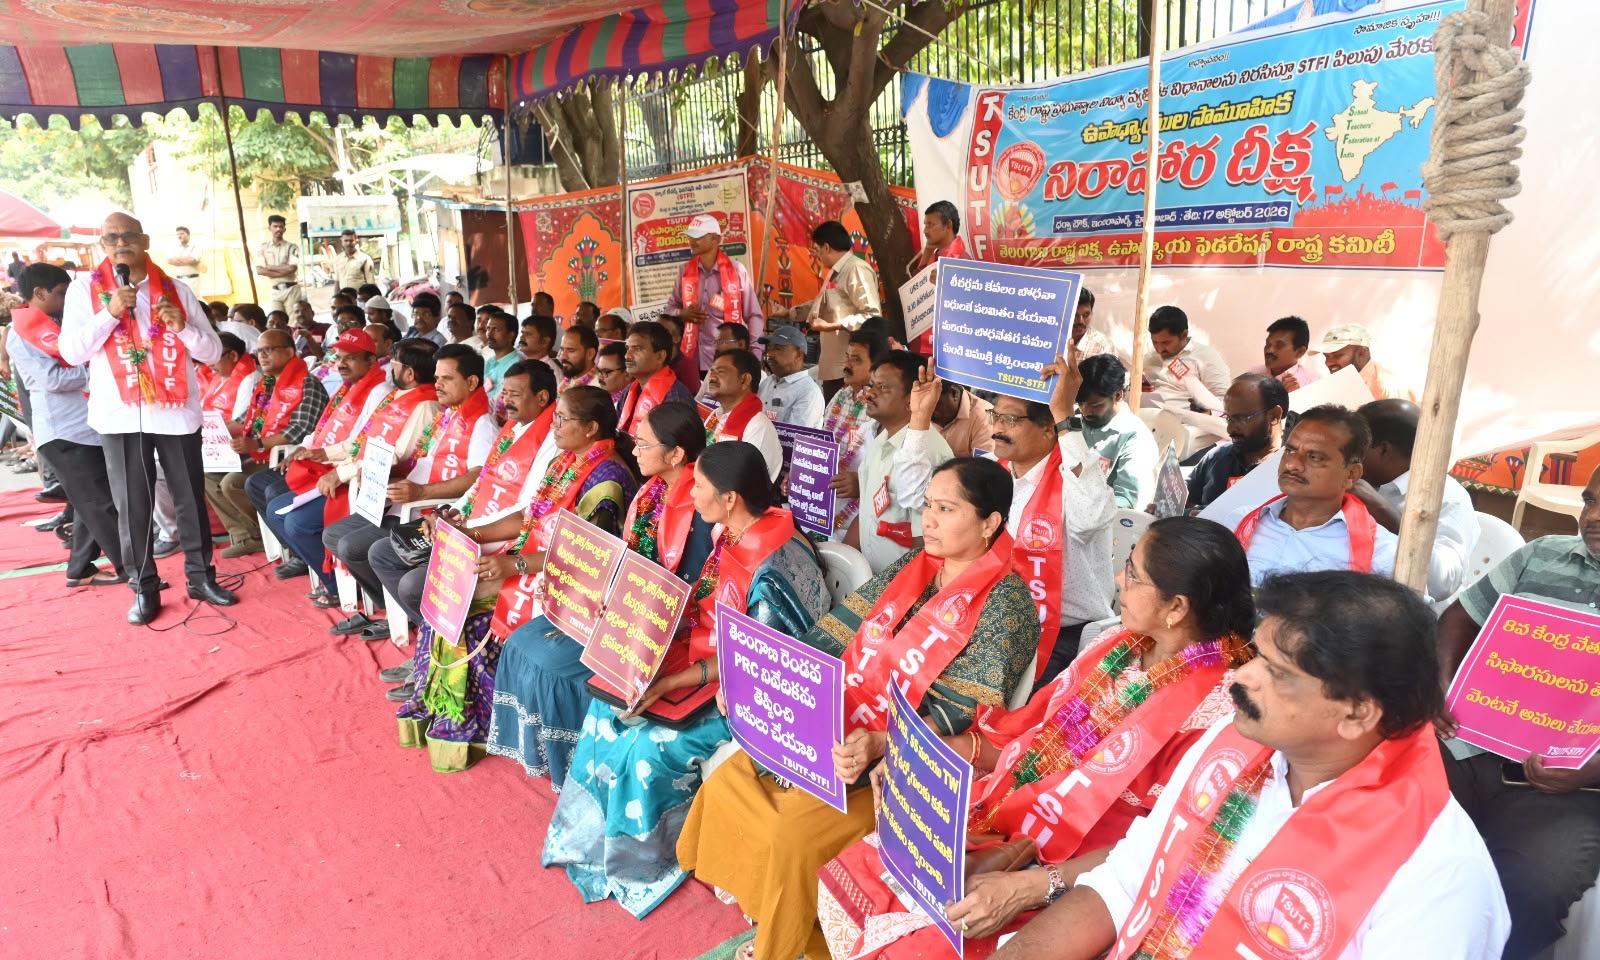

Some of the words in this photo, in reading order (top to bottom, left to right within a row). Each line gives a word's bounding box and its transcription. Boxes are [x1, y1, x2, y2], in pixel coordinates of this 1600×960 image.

[1298, 54, 1330, 75] STFI
[1190, 90, 1296, 128] సామూహిక
[969, 94, 1000, 261] TSUTF
[1226, 121, 1318, 204] దీక్ష
[1203, 209, 1213, 220] 17
[1255, 205, 1288, 219] 2026
[1277, 233, 1324, 263] రాష్ట్ర
[1328, 228, 1395, 254] కమిటీ
[997, 372, 1046, 390] TSUTF-STFI
[729, 621, 779, 663] తెలంగాణ
[780, 647, 822, 685] రెండవ
[734, 651, 759, 679] PRC
[770, 722, 818, 763] చేయాలి
[782, 755, 830, 790] TSUTF-STFI
[943, 768, 960, 795] TW
[1279, 892, 1312, 931] TSUTF
